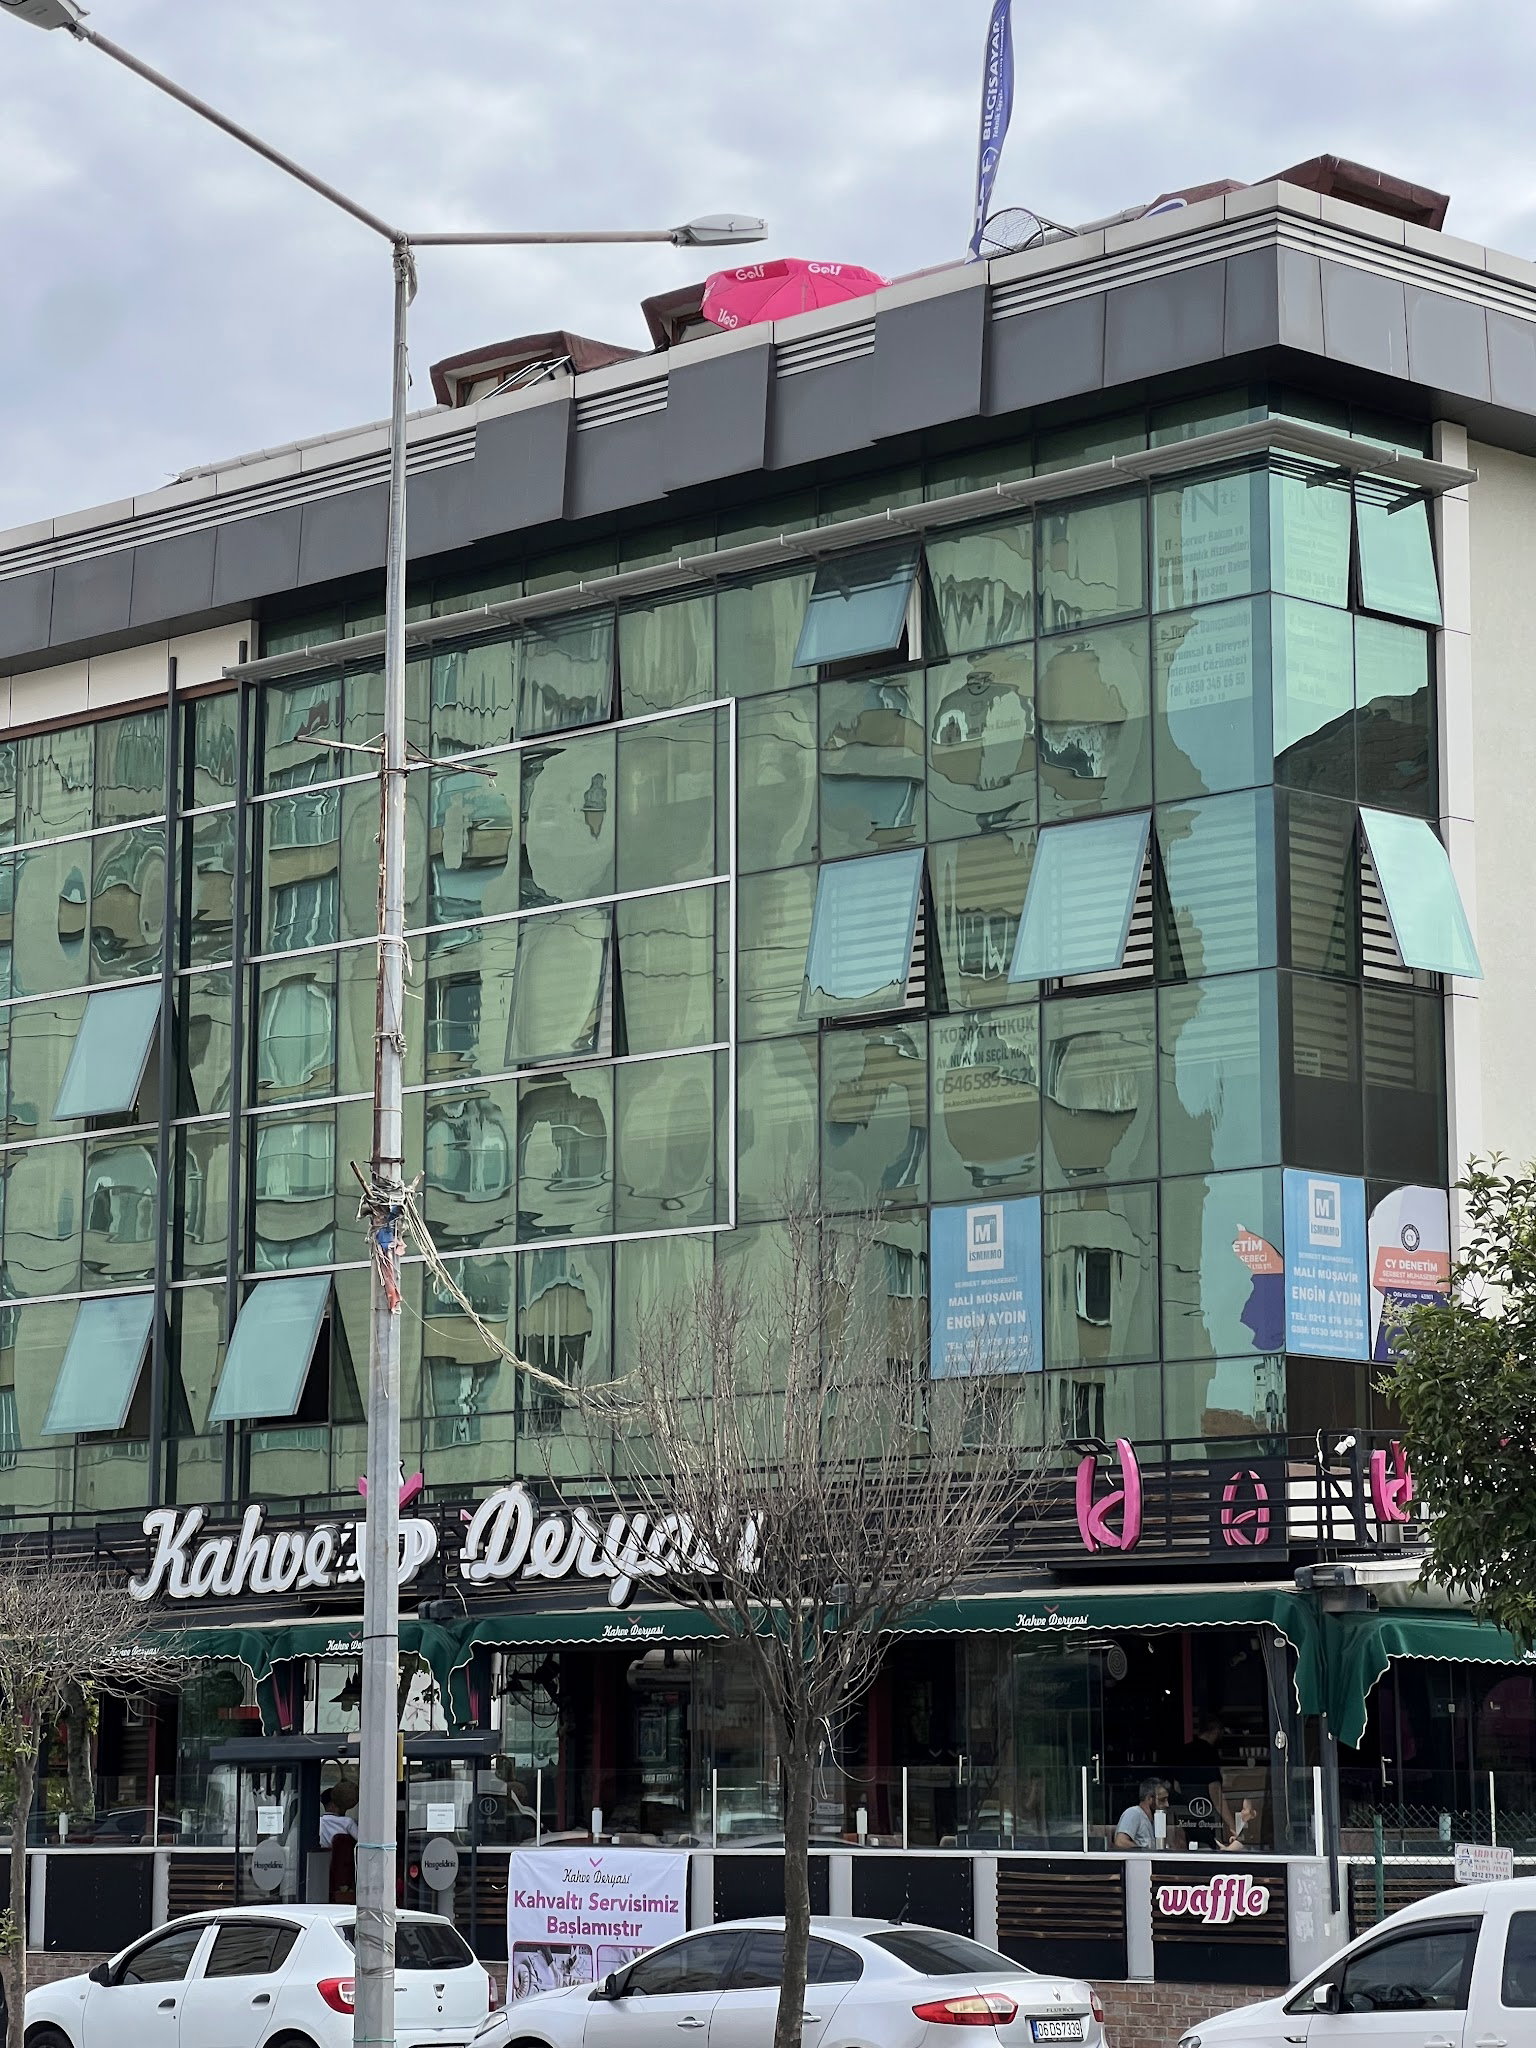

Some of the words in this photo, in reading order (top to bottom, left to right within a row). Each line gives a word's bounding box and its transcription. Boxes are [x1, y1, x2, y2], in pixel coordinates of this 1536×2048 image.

[735, 264, 765, 281] Golf
[808, 263, 842, 276] Golf
[989, 1016, 1035, 1037] HUKUK
[1385, 1258, 1397, 1269] CY
[1399, 1257, 1438, 1273] DENETİM
[1293, 1266, 1316, 1278] MALİ
[1317, 1268, 1359, 1283] MÜŞAVİR
[948, 1294, 974, 1307] MALİ
[976, 1289, 1024, 1305] MÜŞAVİR
[1292, 1285, 1326, 1303] ENGİN
[1328, 1291, 1362, 1306] AYDIN
[946, 1312, 985, 1330] ENGİN
[988, 1310, 1026, 1326] AYDIN
[128, 1504, 335, 1602] Kahve
[1015, 1613, 1047, 1627] Kahve
[602, 1624, 629, 1637] Kahve
[326, 1639, 350, 1651] Kahve
[562, 1868, 591, 1884] Kahve
[514, 1890, 583, 1911] Kahvaltı
[588, 1892, 679, 1914] Servisimiz
[1159, 1877, 1265, 1922] waffle
[547, 1915, 643, 1940] Başlamıştır
